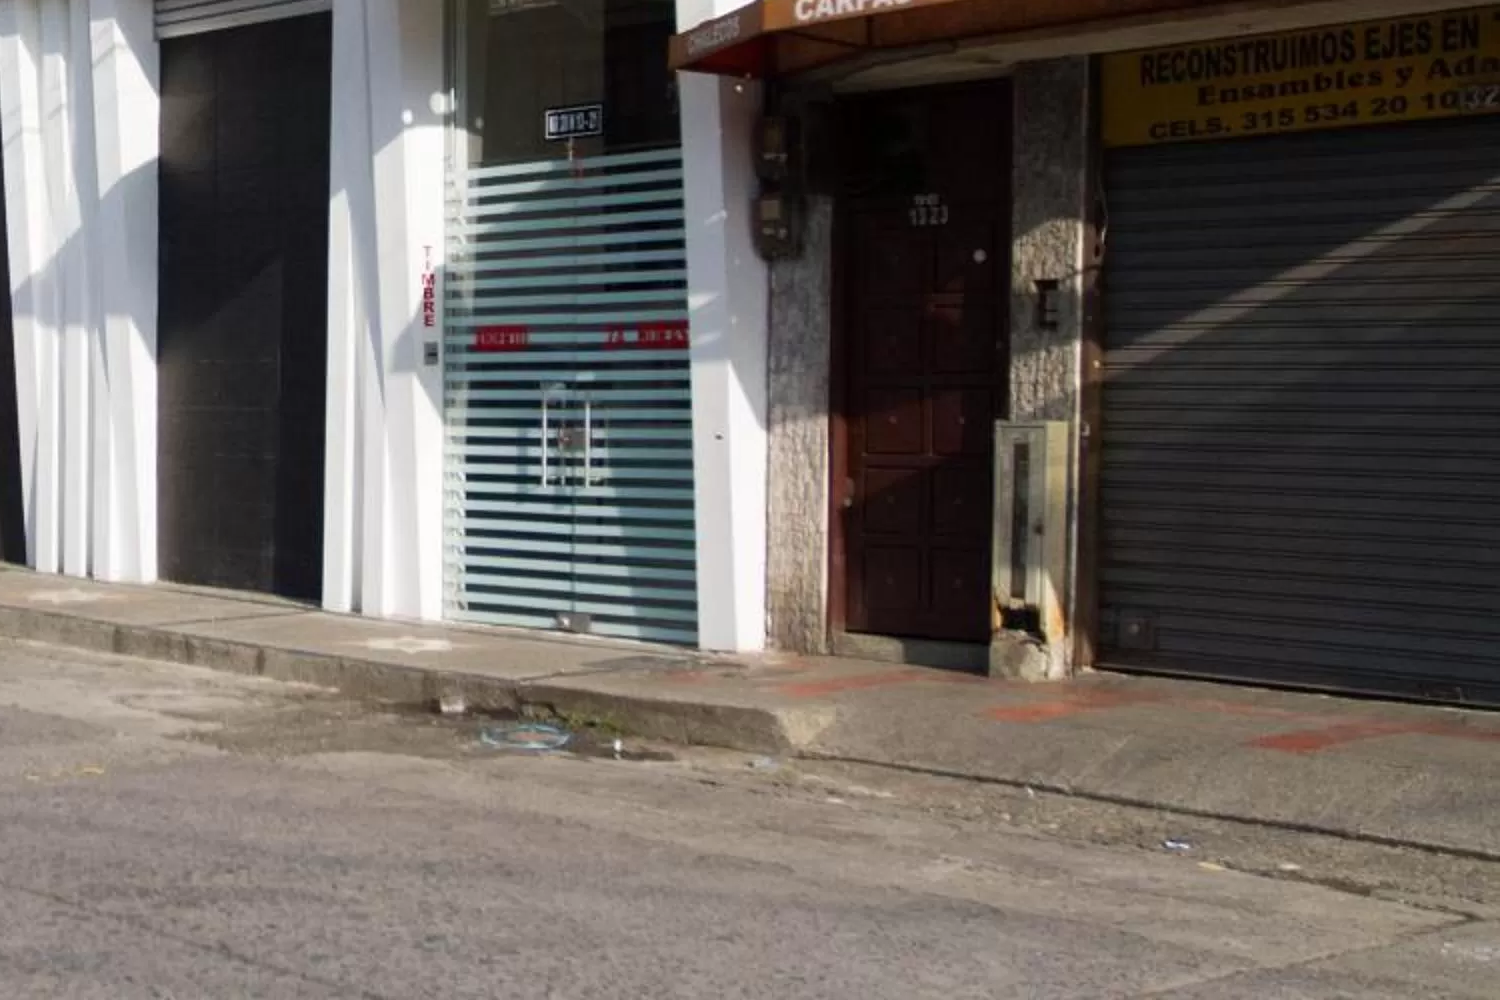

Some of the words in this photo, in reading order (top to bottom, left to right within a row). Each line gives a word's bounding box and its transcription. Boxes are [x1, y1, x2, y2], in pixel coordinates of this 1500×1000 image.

[1141, 28, 1356, 87] RECONSTRUIMOS
[1364, 19, 1433, 61] EJES
[1442, 13, 1480, 51] EN
[1197, 66, 1384, 107] Ensambles
[1394, 65, 1415, 89] y
[1148, 116, 1232, 140] CELS.
[1244, 106, 1295, 131] 315
[1304, 101, 1359, 124] 534
[1371, 95, 1409, 118] 20
[421, 244, 436, 328] TIMBRE
